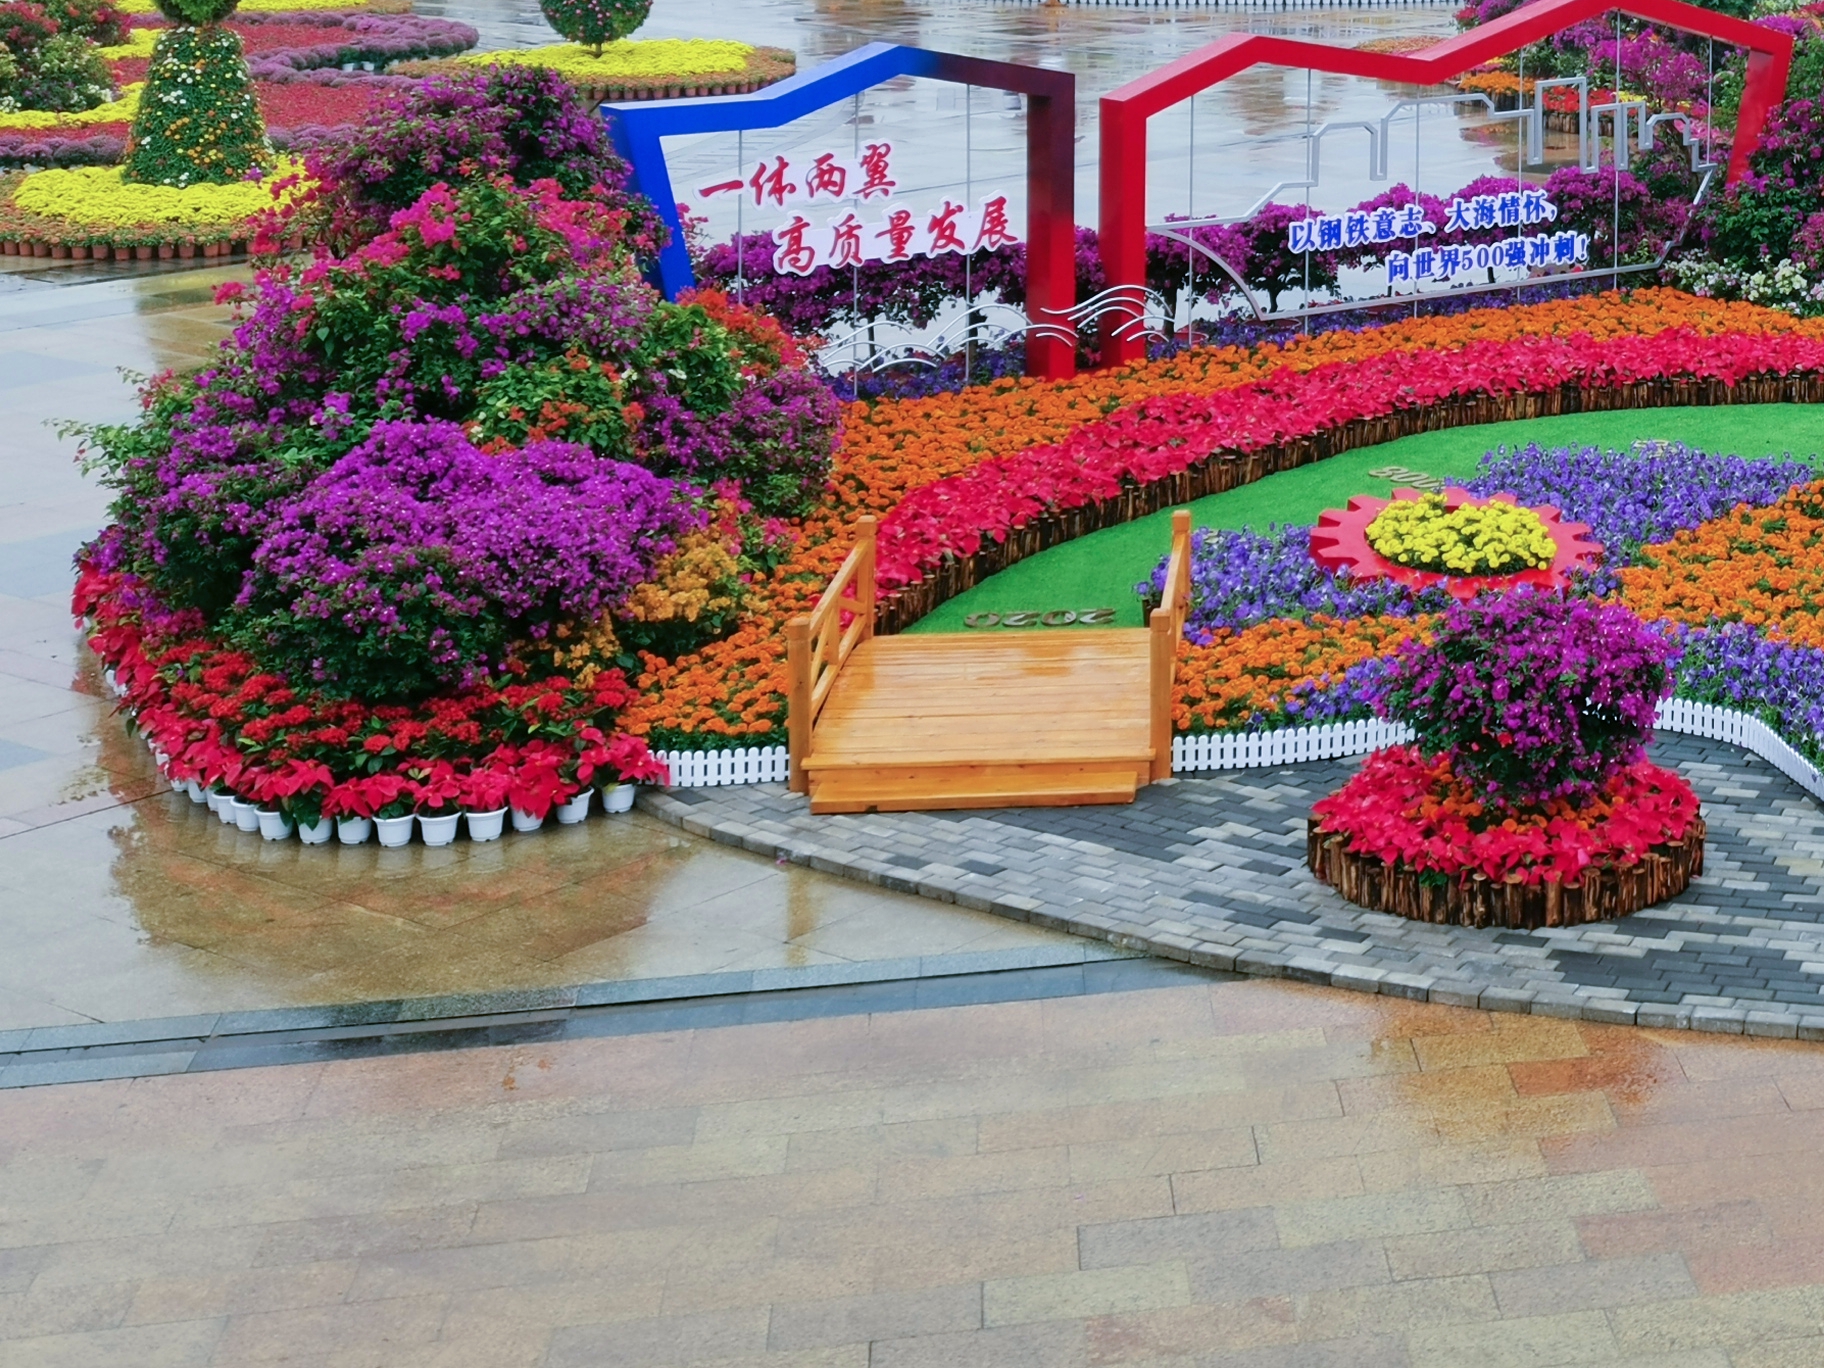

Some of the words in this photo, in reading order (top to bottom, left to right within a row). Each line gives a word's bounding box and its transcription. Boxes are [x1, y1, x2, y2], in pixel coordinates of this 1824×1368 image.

[776, 195, 1018, 272] 高质量发展
